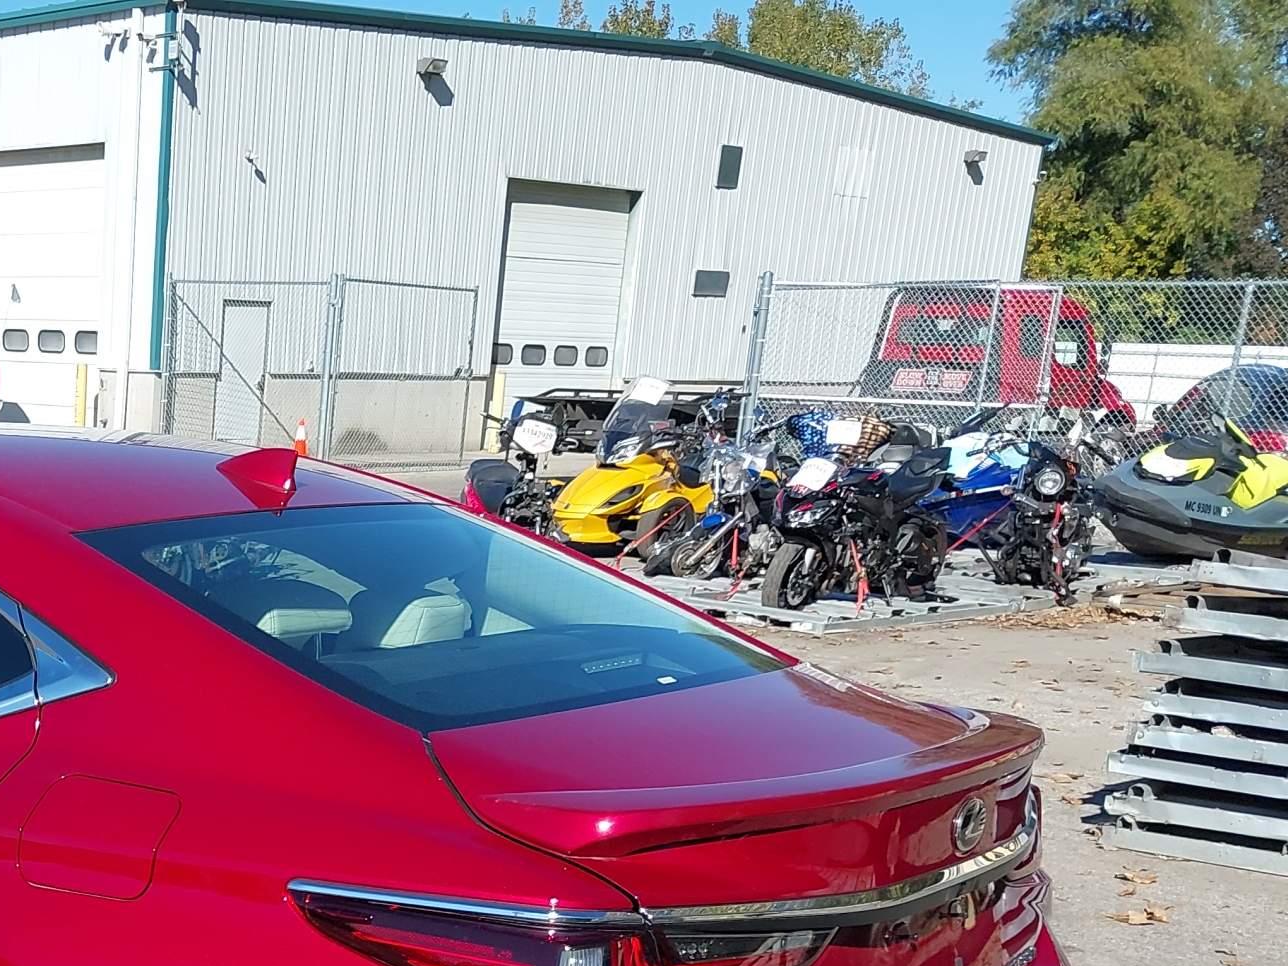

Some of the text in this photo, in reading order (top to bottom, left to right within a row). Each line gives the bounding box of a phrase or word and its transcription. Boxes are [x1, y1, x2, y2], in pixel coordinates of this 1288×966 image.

[899, 371, 923, 379] SLOW
[896, 378, 922, 386] DOWN
[1185, 500, 1196, 512] MC
[1197, 502, 1212, 515] 9309
